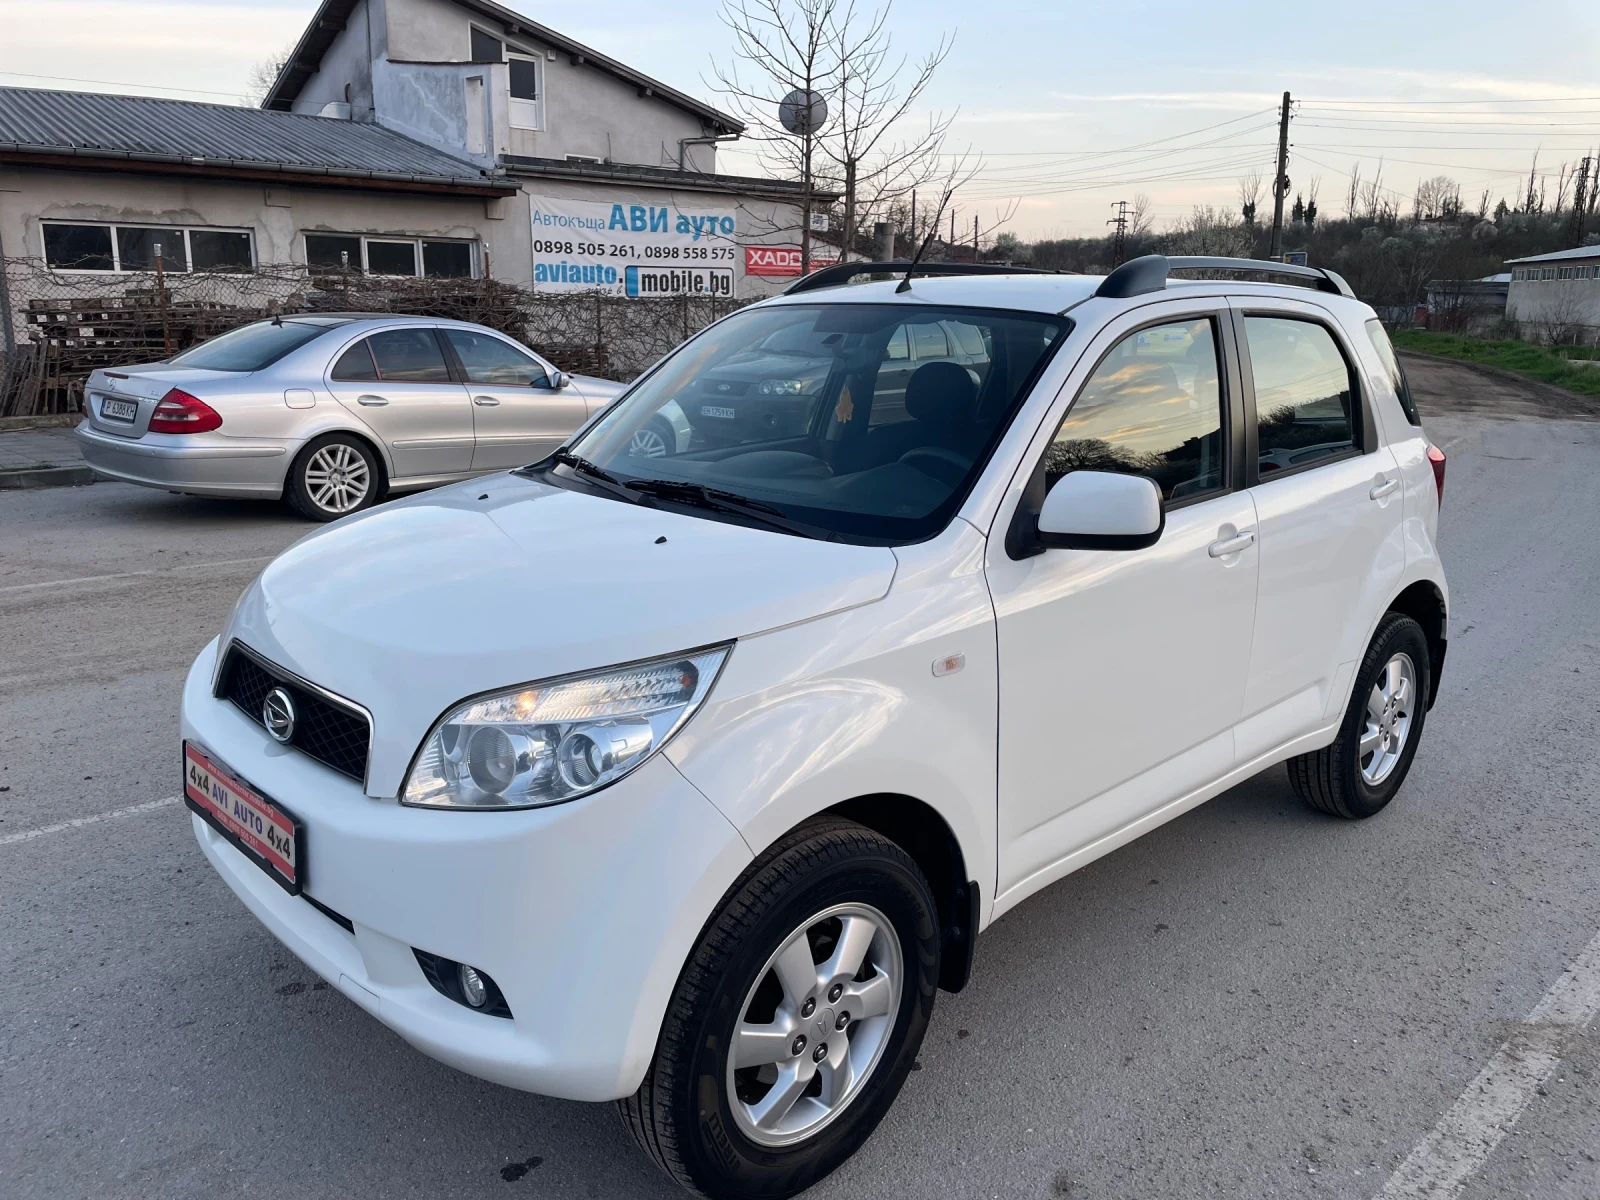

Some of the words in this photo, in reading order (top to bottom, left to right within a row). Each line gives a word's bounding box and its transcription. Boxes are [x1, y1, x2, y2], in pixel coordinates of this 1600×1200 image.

[533, 210, 605, 232] Автокъща
[608, 204, 668, 233] АВИ
[675, 214, 735, 241] ауто
[533, 240, 573, 255] 0898
[577, 243, 605, 256] 505
[609, 244, 641, 259] 261,
[644, 246, 679, 259] 0898
[683, 247, 707, 259] 558
[711, 248, 735, 260] 575
[641, 270, 730, 295] mobile.bg
[105, 401, 112, 412] P
[112, 402, 126, 416] 6388
[125, 404, 135, 417] KH
[189, 765, 210, 795] 4x4
[212, 783, 228, 809] AVI
[234, 800, 263, 835] AUTO
[267, 825, 291, 859] 4x4
